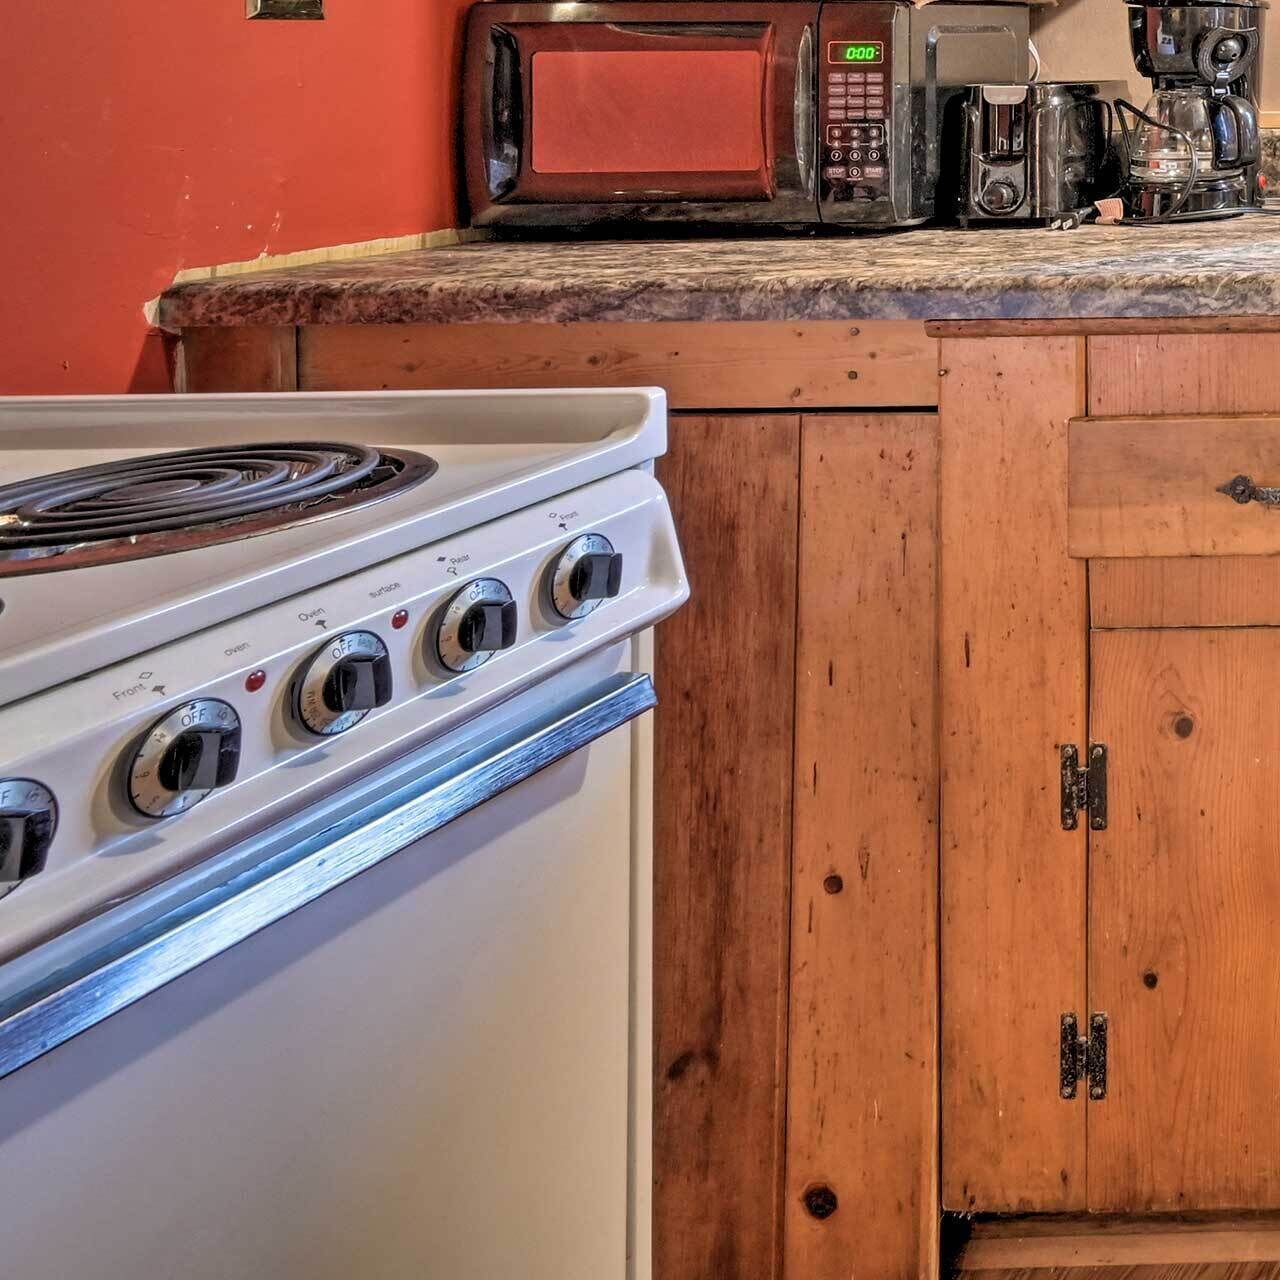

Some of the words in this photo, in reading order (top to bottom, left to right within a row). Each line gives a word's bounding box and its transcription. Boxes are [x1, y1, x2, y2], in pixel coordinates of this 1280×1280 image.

[846, 47, 876, 60] 0:00
[369, 582, 401, 598] surface
[469, 586, 487, 601] OFF
[298, 607, 326, 622] Oven
[332, 640, 354, 659] OFF
[112, 682, 145, 701] Front
[181, 708, 208, 727] OFF
